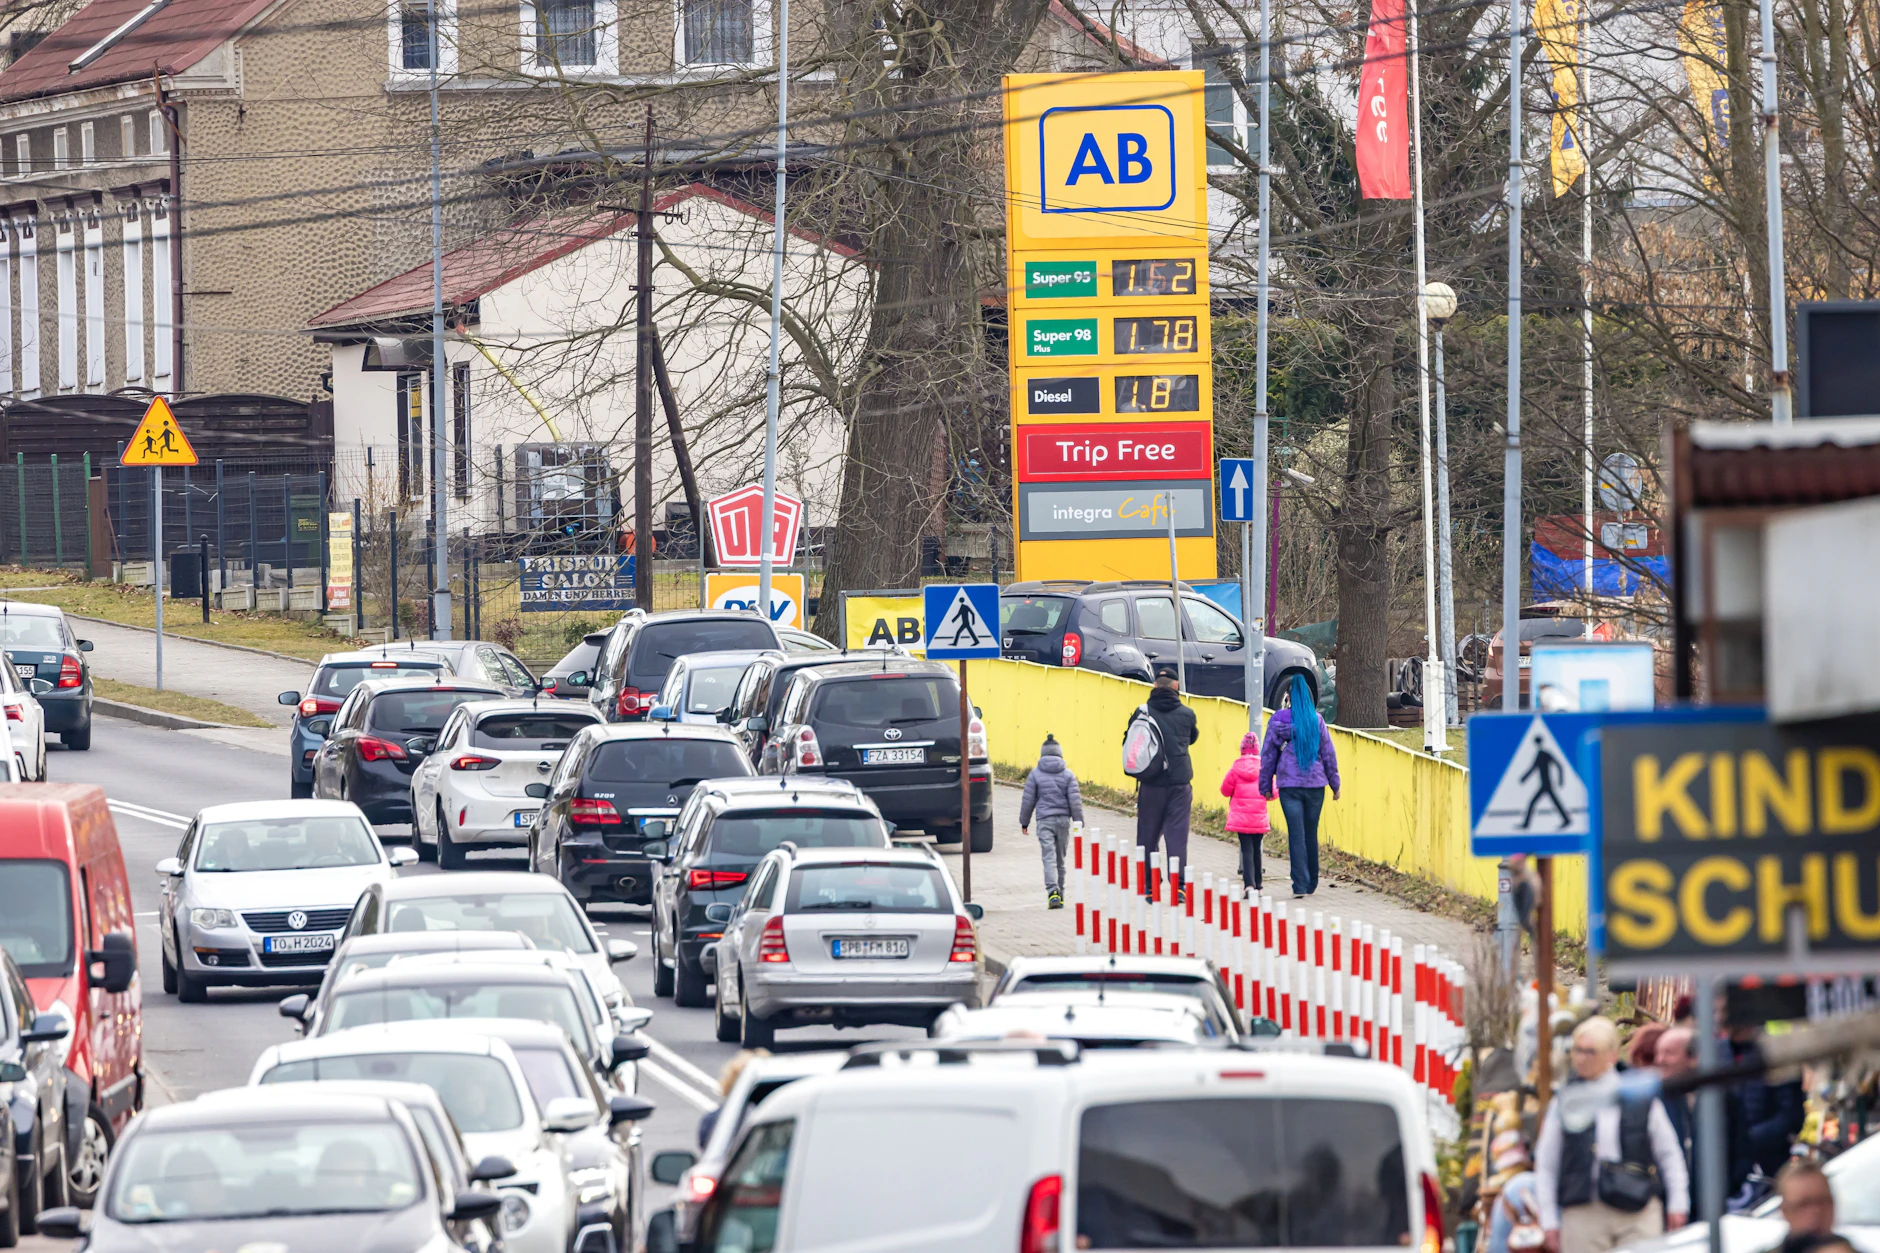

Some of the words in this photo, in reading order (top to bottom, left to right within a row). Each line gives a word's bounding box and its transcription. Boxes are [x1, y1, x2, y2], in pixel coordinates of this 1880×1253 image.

[1065, 132, 1153, 186] AB
[1032, 272, 1072, 287] Super
[1074, 271, 1091, 283] 95
[1033, 330, 1072, 344] Super
[1074, 329, 1092, 341] 98
[1129, 319, 1194, 350] 1.78
[1033, 345, 1051, 353] Plus
[1034, 388, 1072, 403] Diesel
[1056, 440, 1109, 466] Trip
[1118, 440, 1176, 461] Free
[1053, 504, 1112, 523] integra
[523, 556, 619, 573] FRISEUR
[541, 572, 616, 589] SALON
[565, 590, 589, 600] UND
[868, 750, 889, 761] FZA
[891, 749, 923, 761] 33154
[1633, 745, 1880, 843] KIND
[272, 939, 287, 949] TO
[294, 938, 302, 949] H
[303, 937, 331, 948] 2024
[841, 942, 861, 953] SPB
[886, 941, 907, 953] 816
